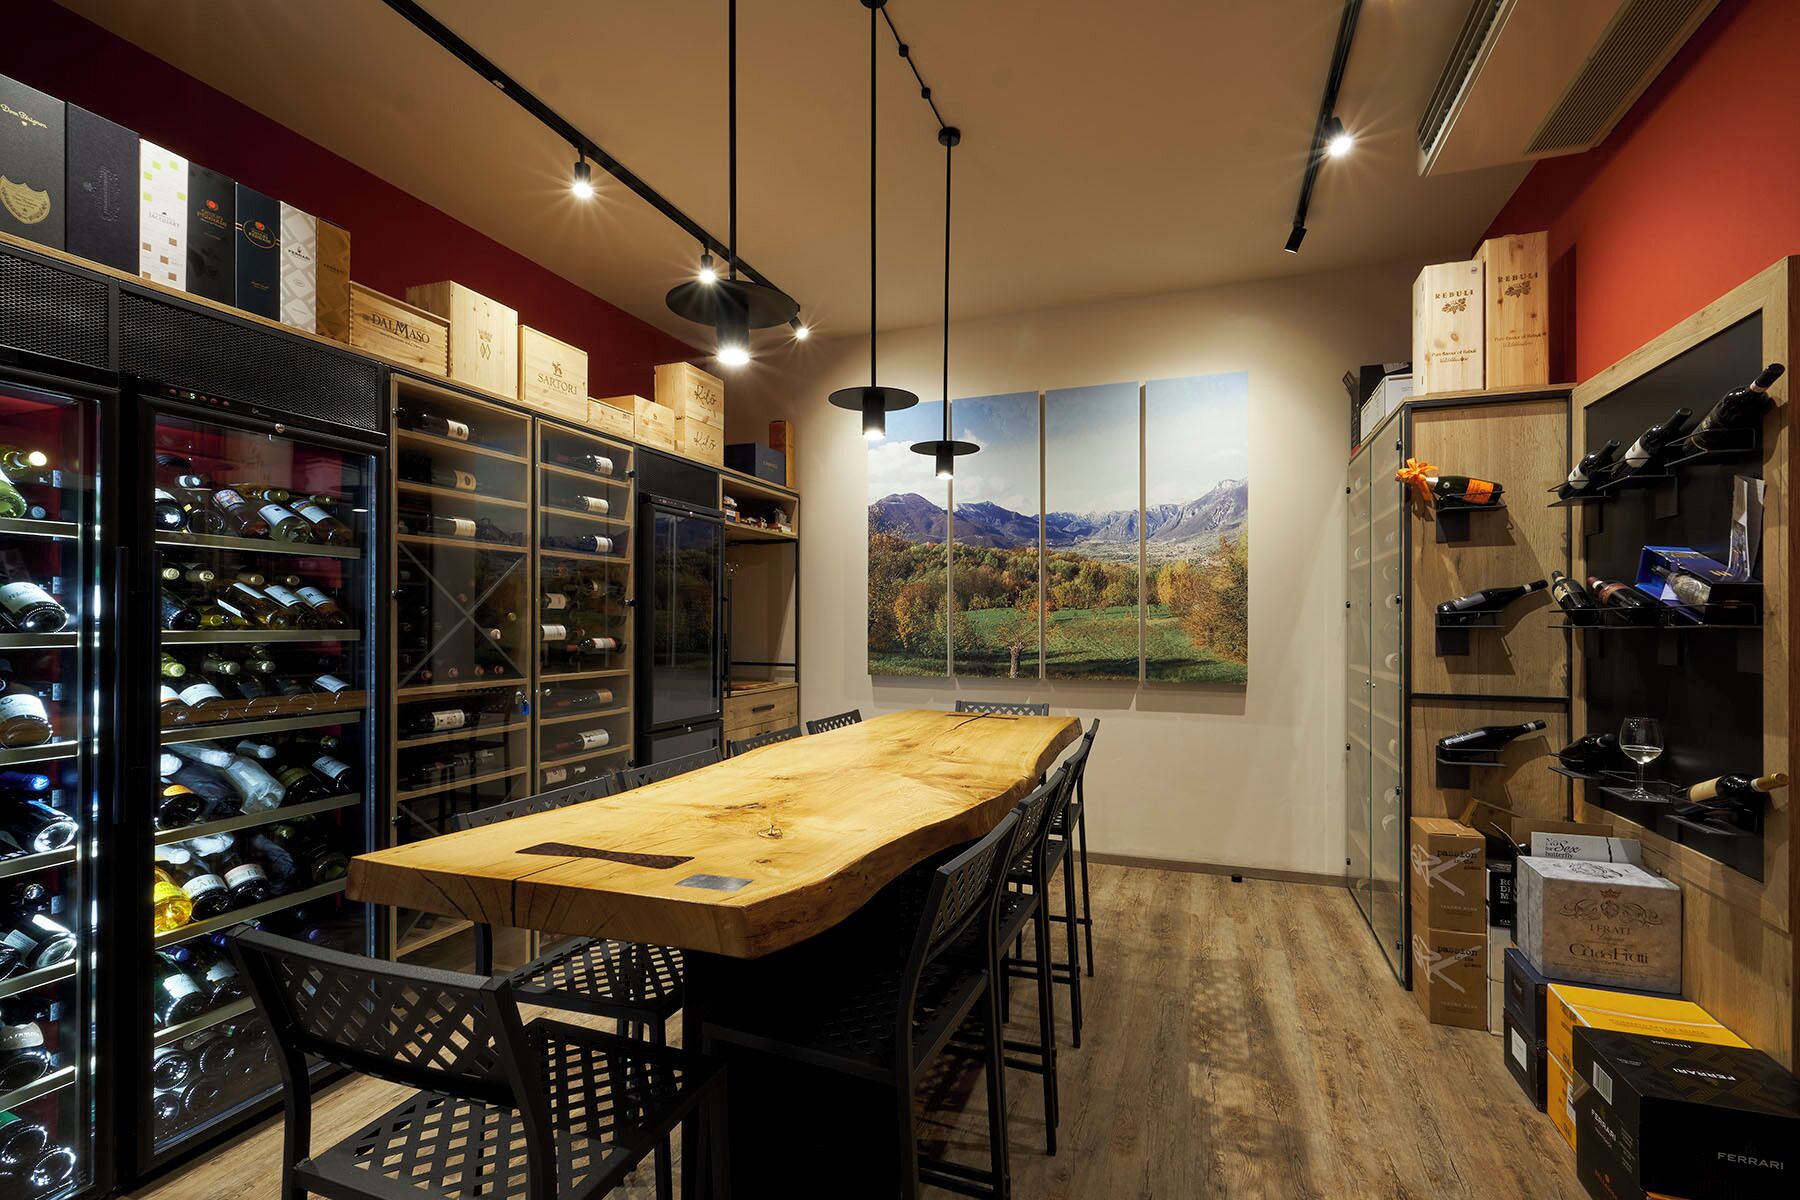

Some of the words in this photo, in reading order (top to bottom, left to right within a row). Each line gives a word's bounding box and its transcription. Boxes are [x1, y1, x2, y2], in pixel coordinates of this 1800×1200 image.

[1497, 271, 1539, 282] REBULI
[1435, 289, 1474, 299] REBULI
[538, 372, 577, 396] SARTORI
[1545, 837, 1559, 846] No
[1554, 840, 1581, 854] Sex
[1437, 849, 1477, 858] passion
[1437, 946, 1477, 956] passion
[1672, 1067, 1737, 1081] FERRARI
[1717, 1151, 1784, 1170] FERRARI
